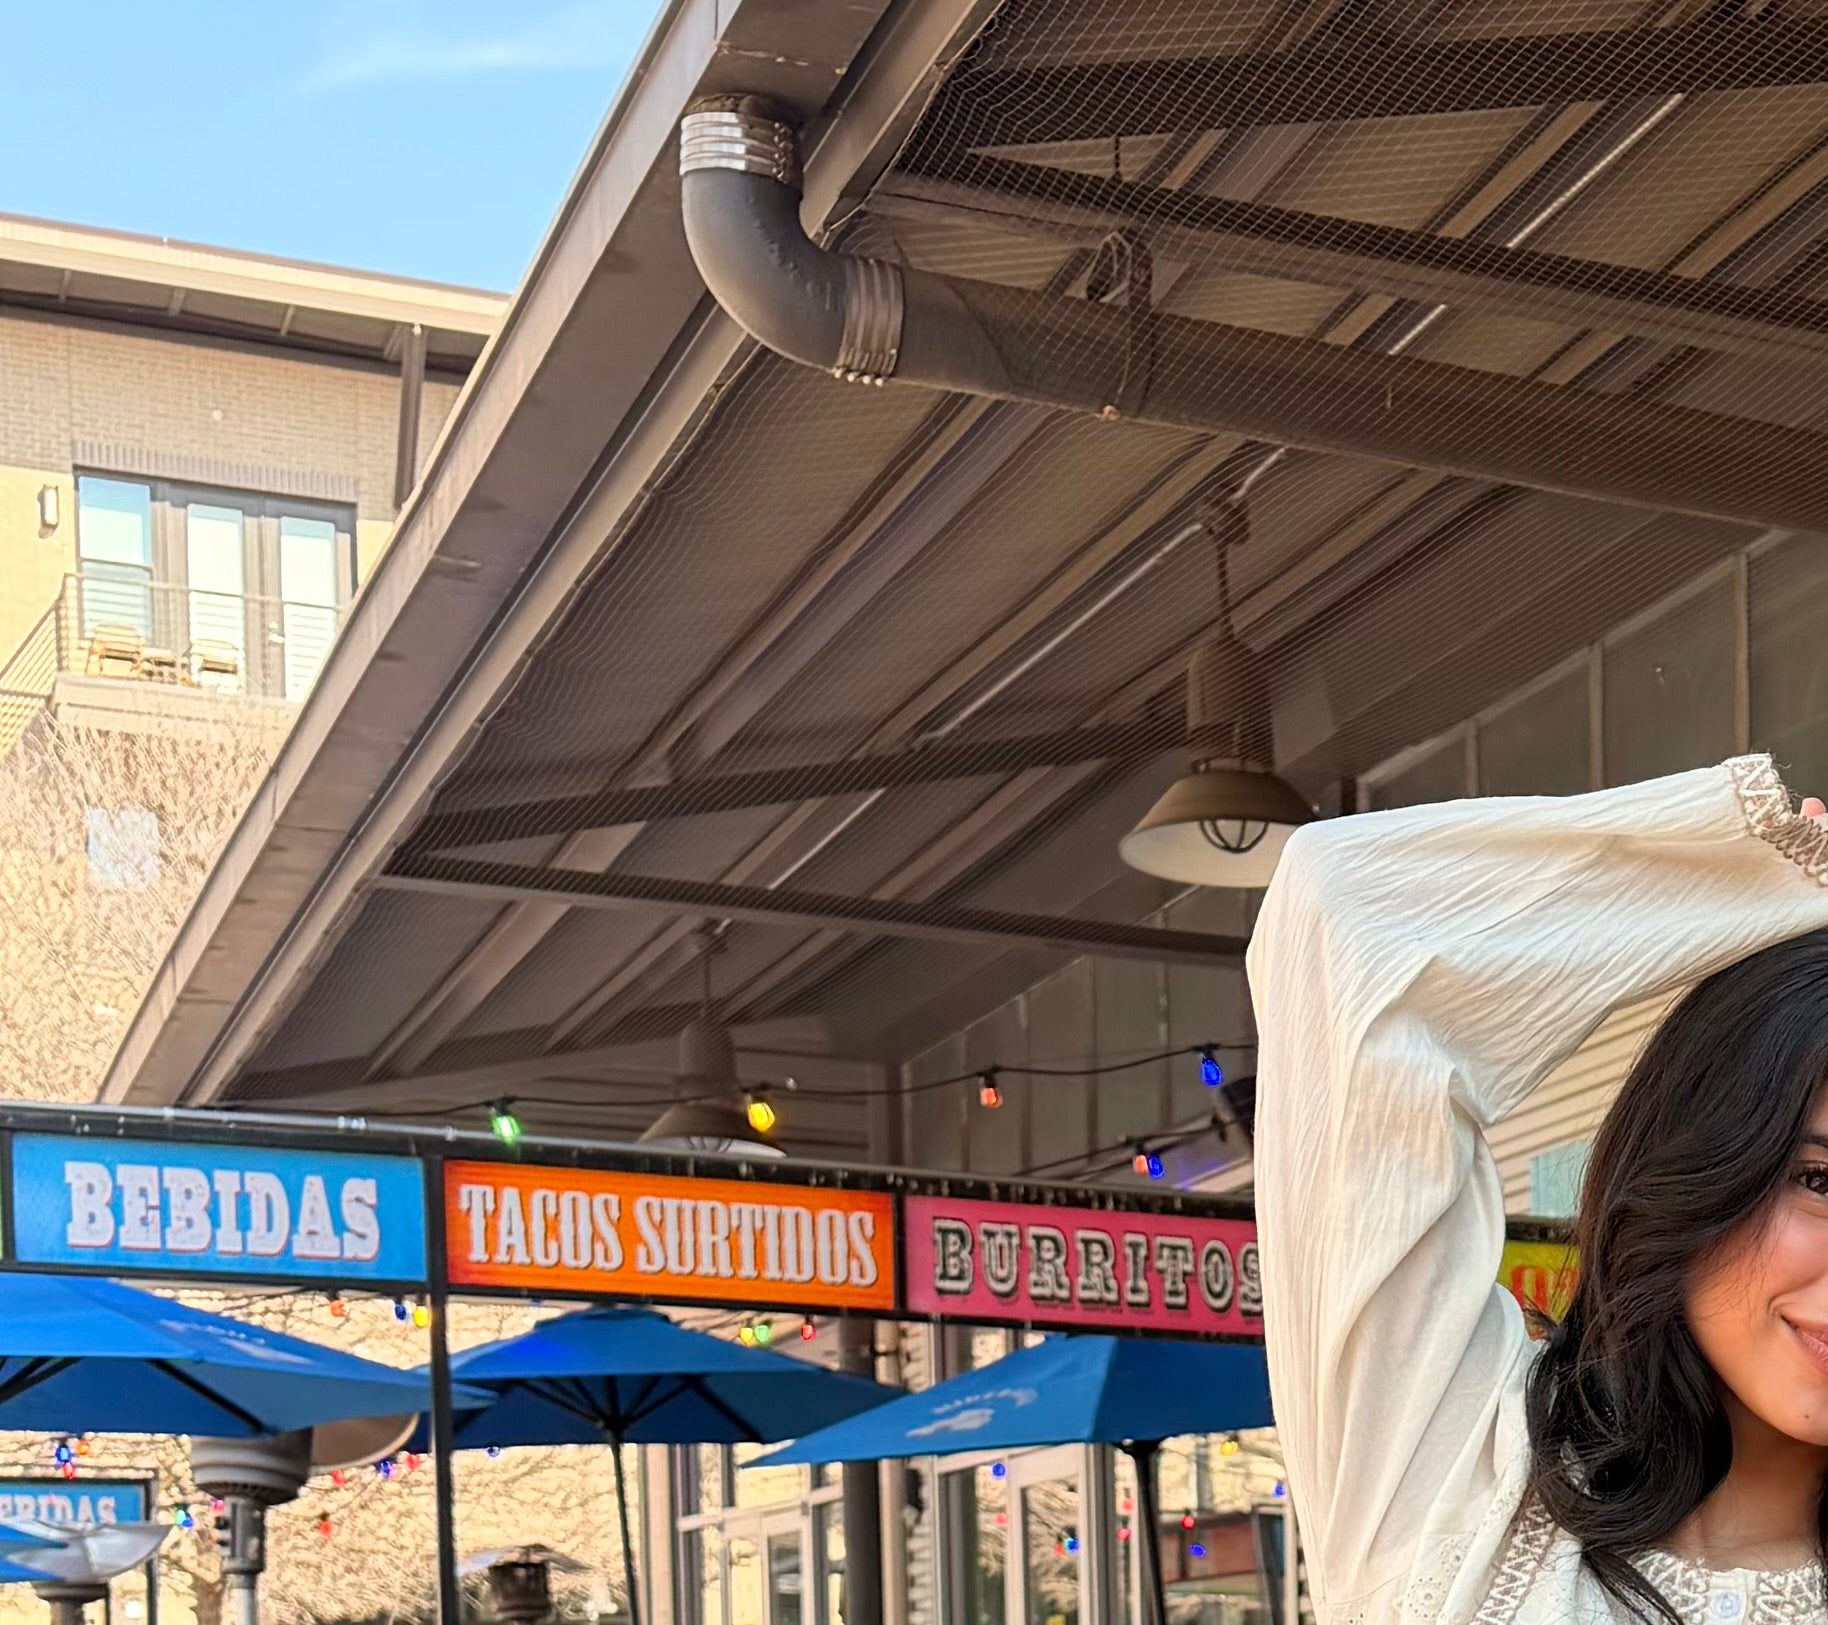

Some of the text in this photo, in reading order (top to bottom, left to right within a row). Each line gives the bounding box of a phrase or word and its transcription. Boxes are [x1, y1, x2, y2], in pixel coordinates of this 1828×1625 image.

[63, 1160, 381, 1262] BEBIDAS
[458, 1183, 879, 1289] TACOS SURTIDOS
[931, 1217, 1263, 1316] BURRITOS
